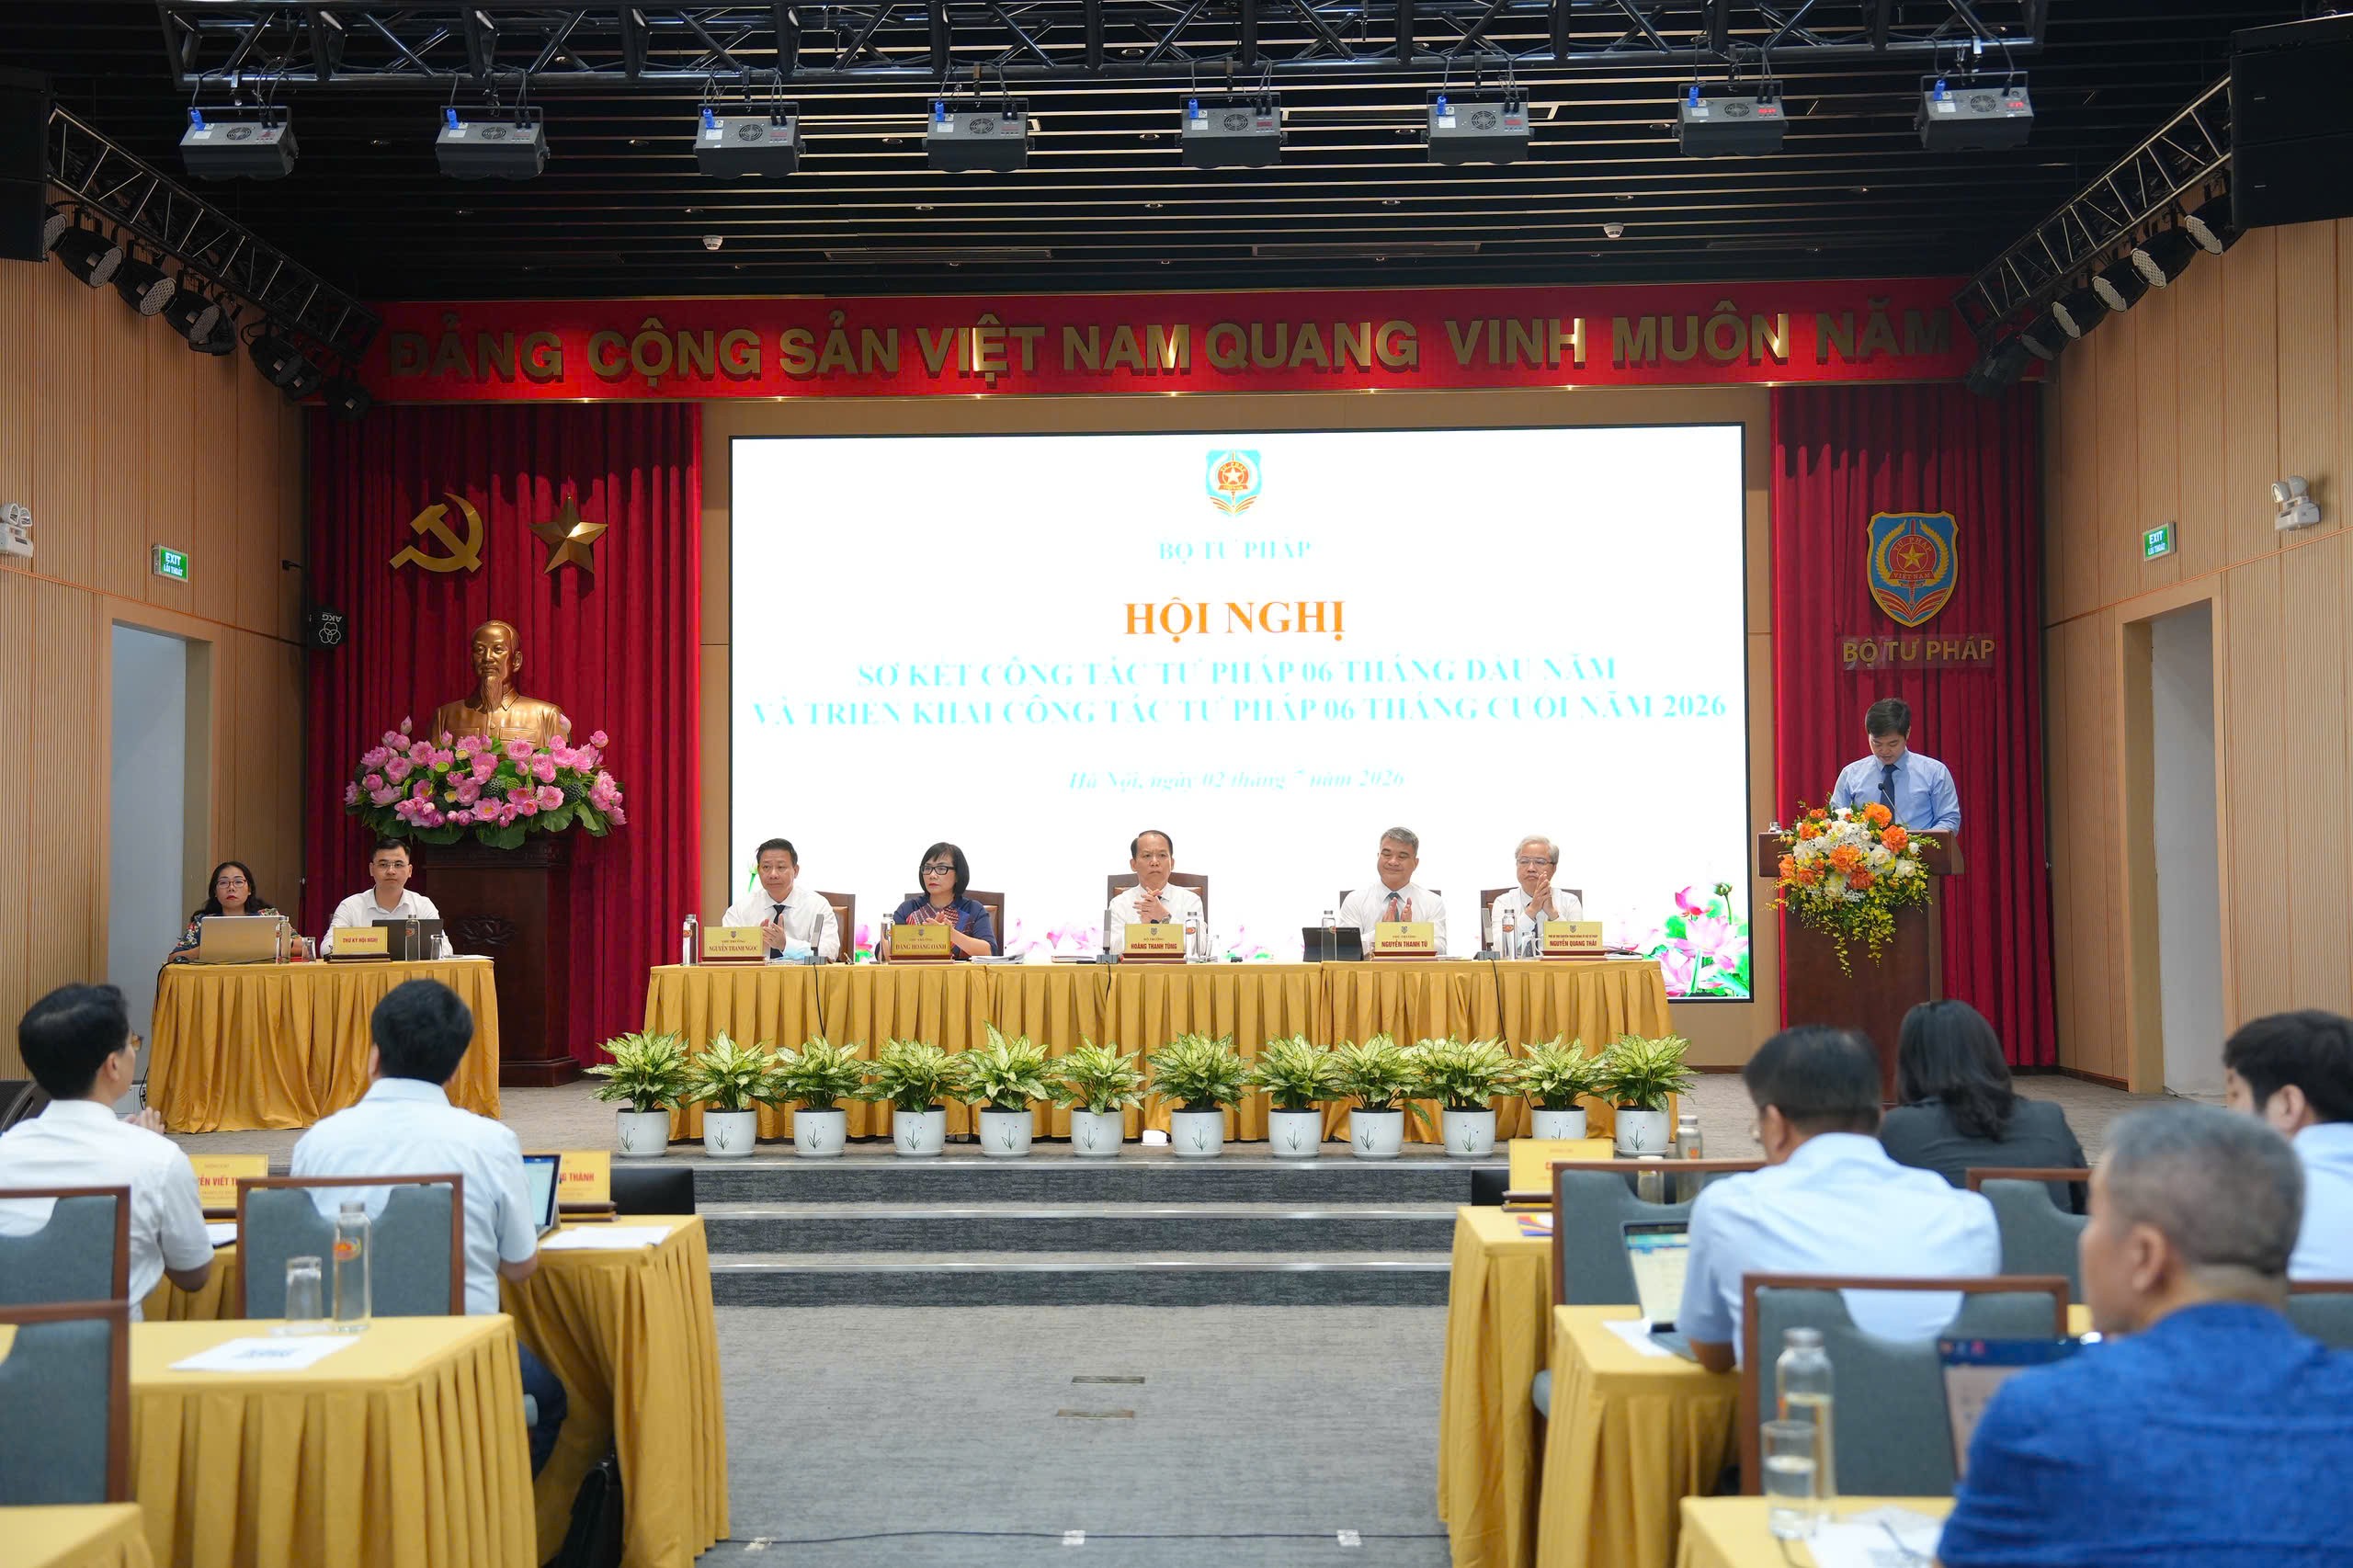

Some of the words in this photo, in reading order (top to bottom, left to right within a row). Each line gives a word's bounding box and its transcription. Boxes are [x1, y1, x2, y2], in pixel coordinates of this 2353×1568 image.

[390, 313, 564, 382] ĐẢNG
[588, 317, 761, 387] CỘNG
[779, 310, 900, 376] SẢN
[916, 313, 1046, 381] VIỆT
[1063, 324, 1192, 375] NAM
[1204, 319, 1419, 369] QUANG
[1445, 317, 1587, 365] VINH
[1612, 300, 1791, 365] MUÔN
[1816, 297, 1950, 360] NĂM
[2149, 530, 2164, 544] EXIT
[165, 551, 181, 565] EXIT
[1123, 596, 1211, 643] HỘI
[1224, 600, 1347, 642] NGHỊ
[1843, 639, 1879, 668] BỘ
[1884, 638, 1920, 662] TƯ
[1927, 636, 1995, 661] PHÁP
[1302, 661, 1333, 683] 06
[913, 700, 994, 726] KHAI
[1324, 699, 1356, 722] 06
[1662, 693, 1728, 718] 2026
